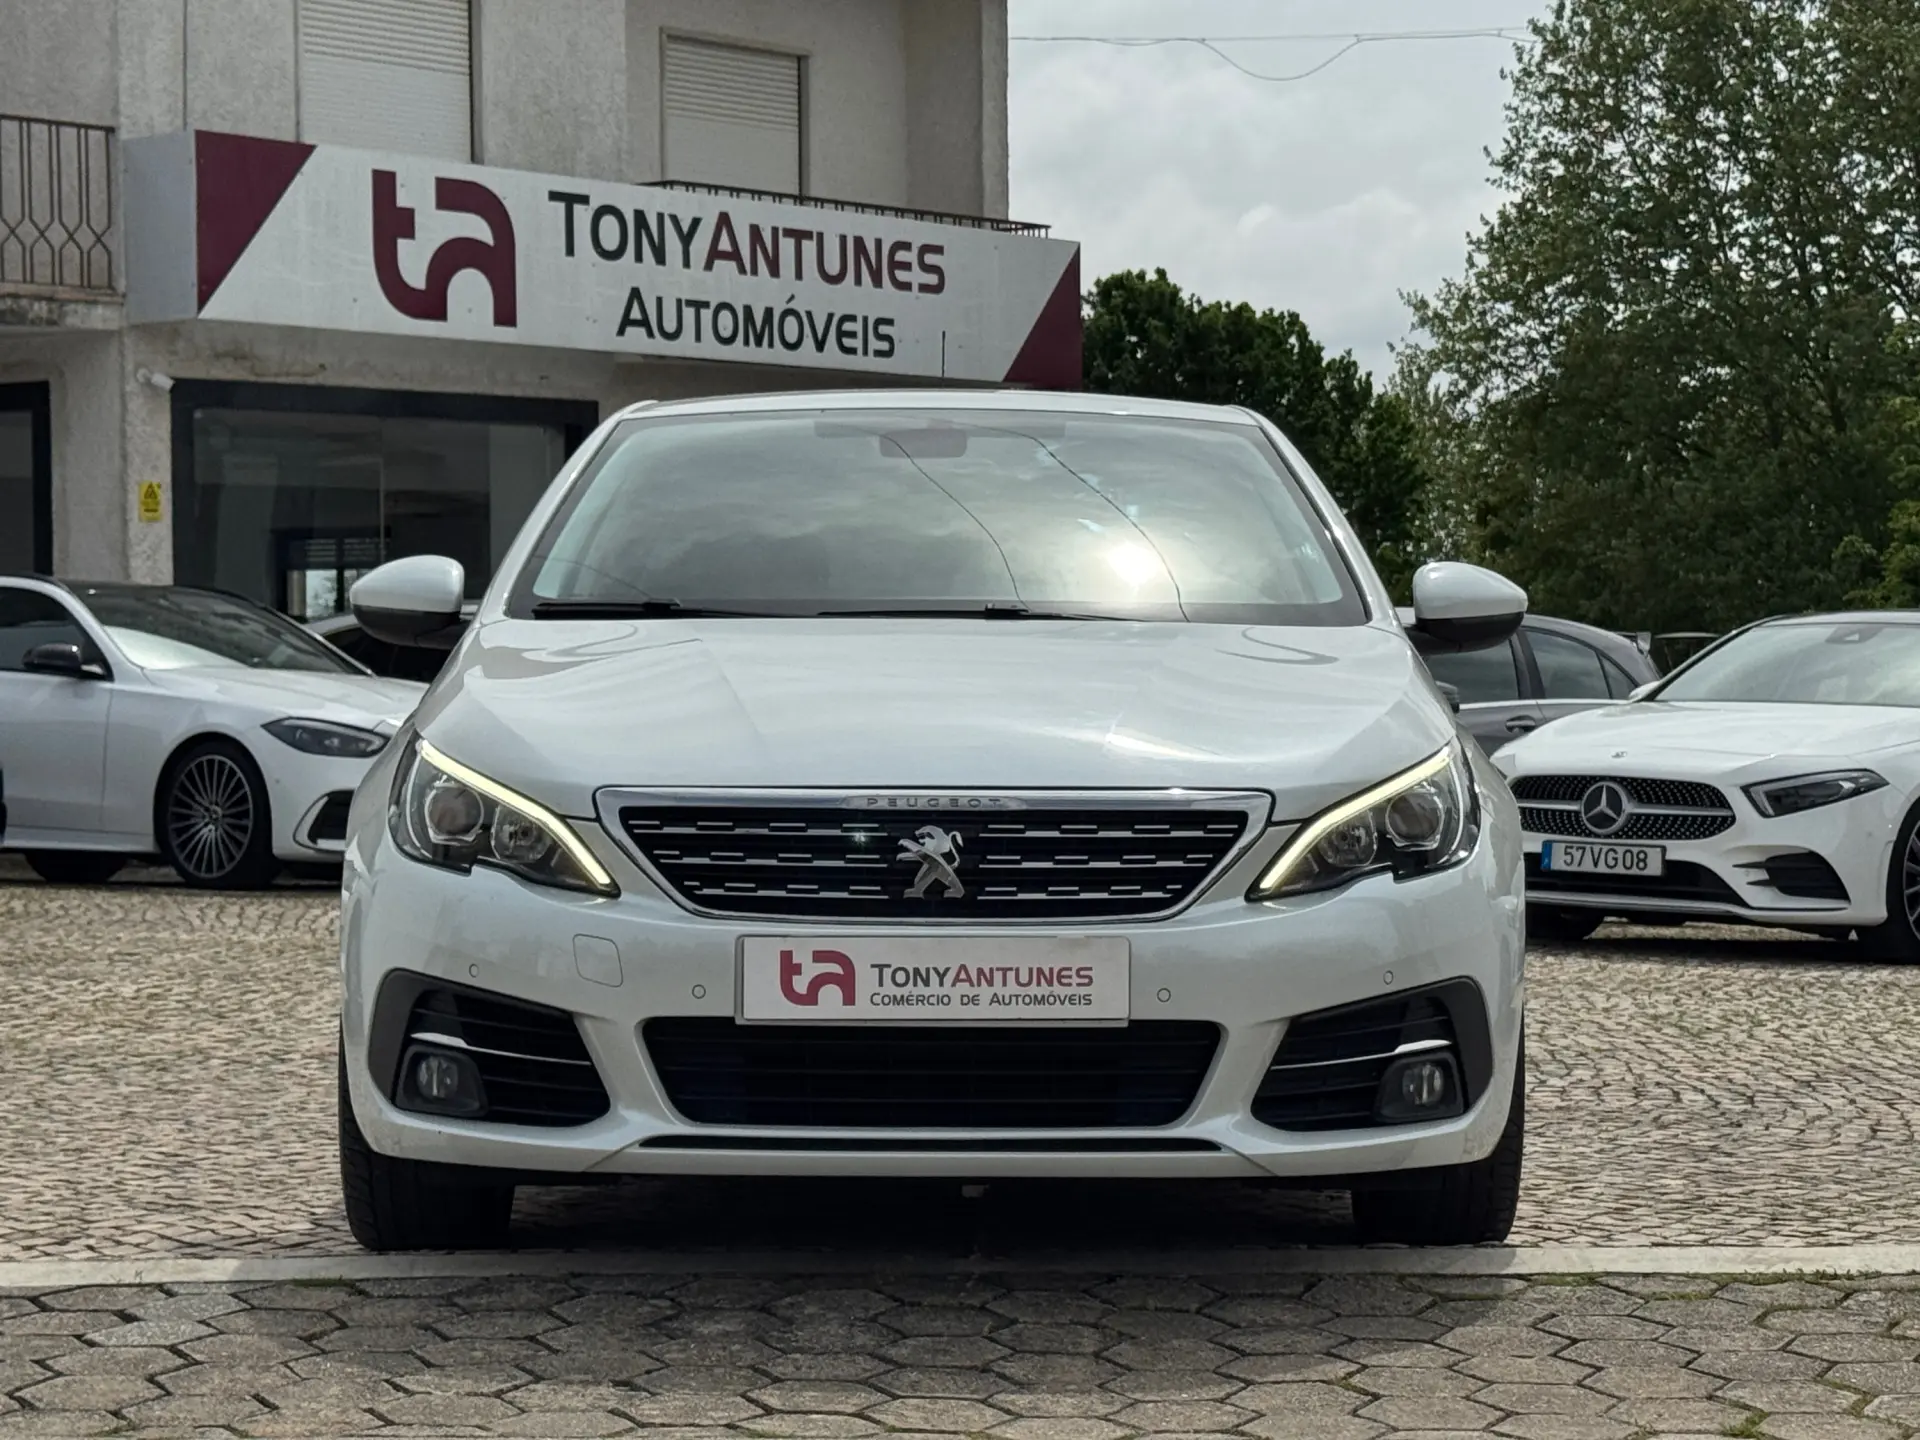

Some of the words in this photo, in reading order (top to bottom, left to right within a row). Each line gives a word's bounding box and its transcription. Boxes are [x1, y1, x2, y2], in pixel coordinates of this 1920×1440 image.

[548, 190, 945, 294] TONYANTUNES
[616, 286, 895, 358] AUTOMÓVEIS
[867, 798, 1000, 807] PEUGEOT
[1563, 845, 1648, 871] 57VG08
[870, 963, 1094, 988] TONYANTUNES
[870, 990, 951, 1006] COMÉRCIO
[960, 993, 980, 1006] DE
[988, 990, 1093, 1006] AUTOMÓVEIS
